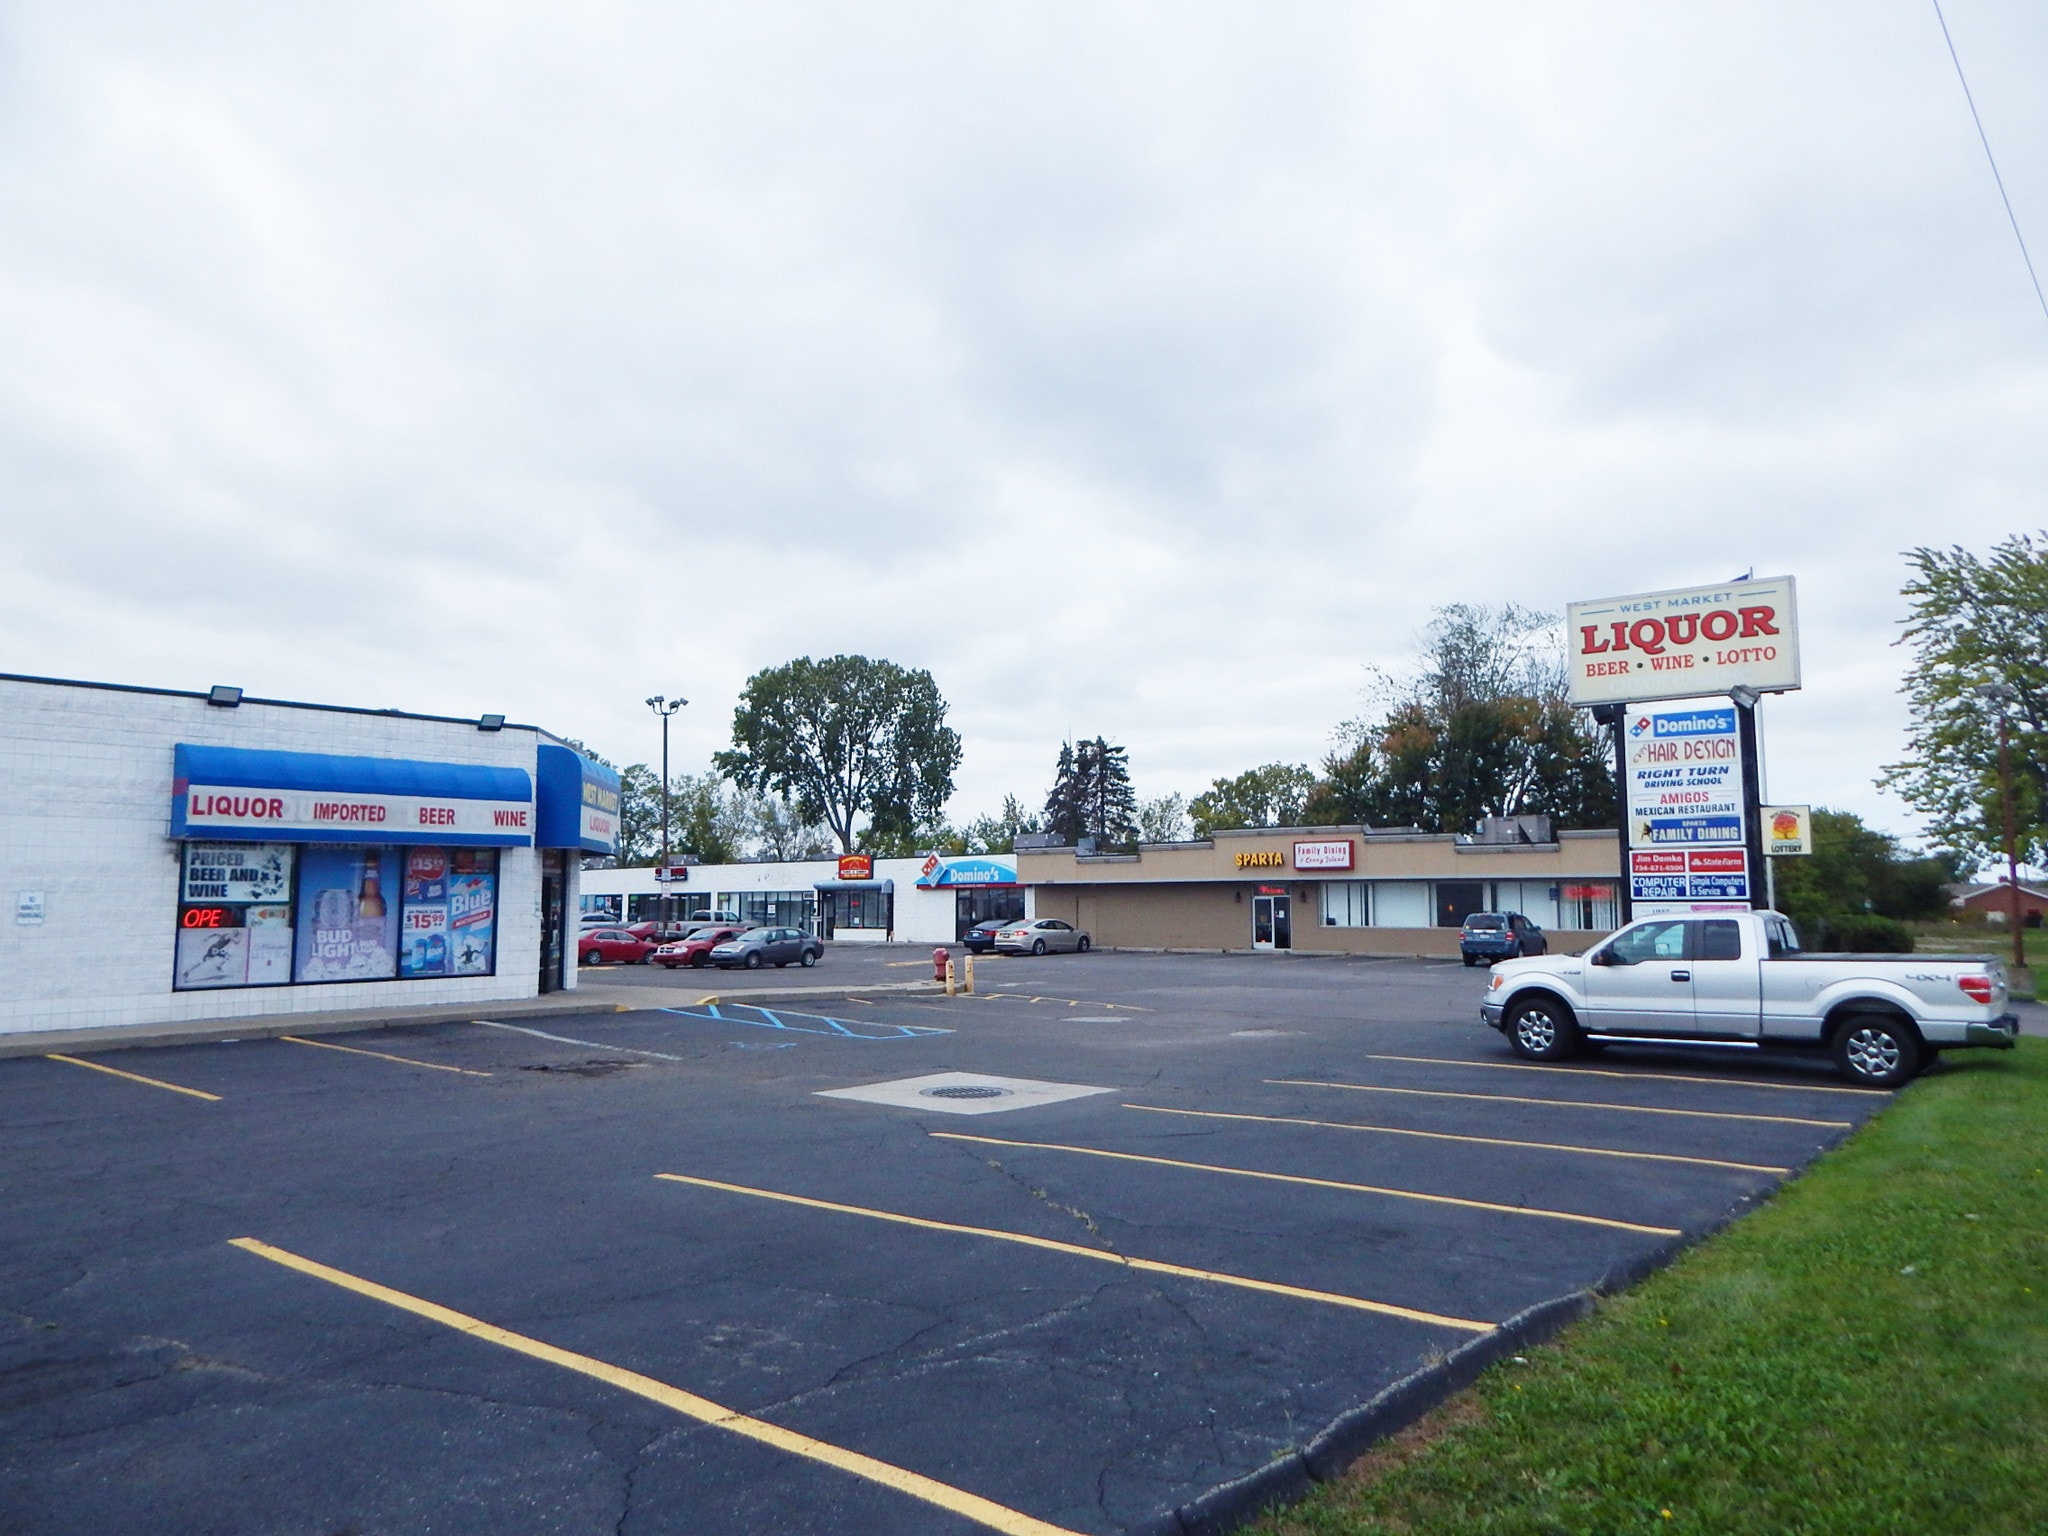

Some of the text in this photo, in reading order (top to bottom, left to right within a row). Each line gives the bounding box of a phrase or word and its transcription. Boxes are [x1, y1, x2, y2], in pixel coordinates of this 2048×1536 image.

[1620, 592, 1733, 613] WEST MARKET
[1580, 605, 1780, 655] LIQUOR
[1586, 646, 1777, 677] BEER WINE LOTTO
[1657, 714, 1728, 733] Domino's
[1647, 742, 1679, 763] HAIR
[1684, 738, 1736, 760] DESIGN
[1637, 766, 1729, 779] RIGHT TURN
[1644, 777, 1722, 788] DRIVING SCHOOL
[1660, 791, 1709, 804] AMIGOS
[192, 795, 527, 827] LIQUOR IMPORTED BEER WINE
[1635, 803, 1736, 816] MEXICAN RESTAURANT
[1652, 826, 1739, 840] FAMILY DINING
[190, 852, 245, 866] PRICED
[1235, 852, 1284, 866] SPARTA
[190, 868, 260, 882] BEER AND
[950, 866, 1000, 882] Domino's
[1633, 877, 1686, 888] COMPUTER
[188, 884, 228, 897] WINE
[1641, 887, 1678, 897] REPAIR
[452, 892, 492, 917] Blue
[316, 929, 352, 943] BUD
[311, 942, 357, 958] LIGHT
